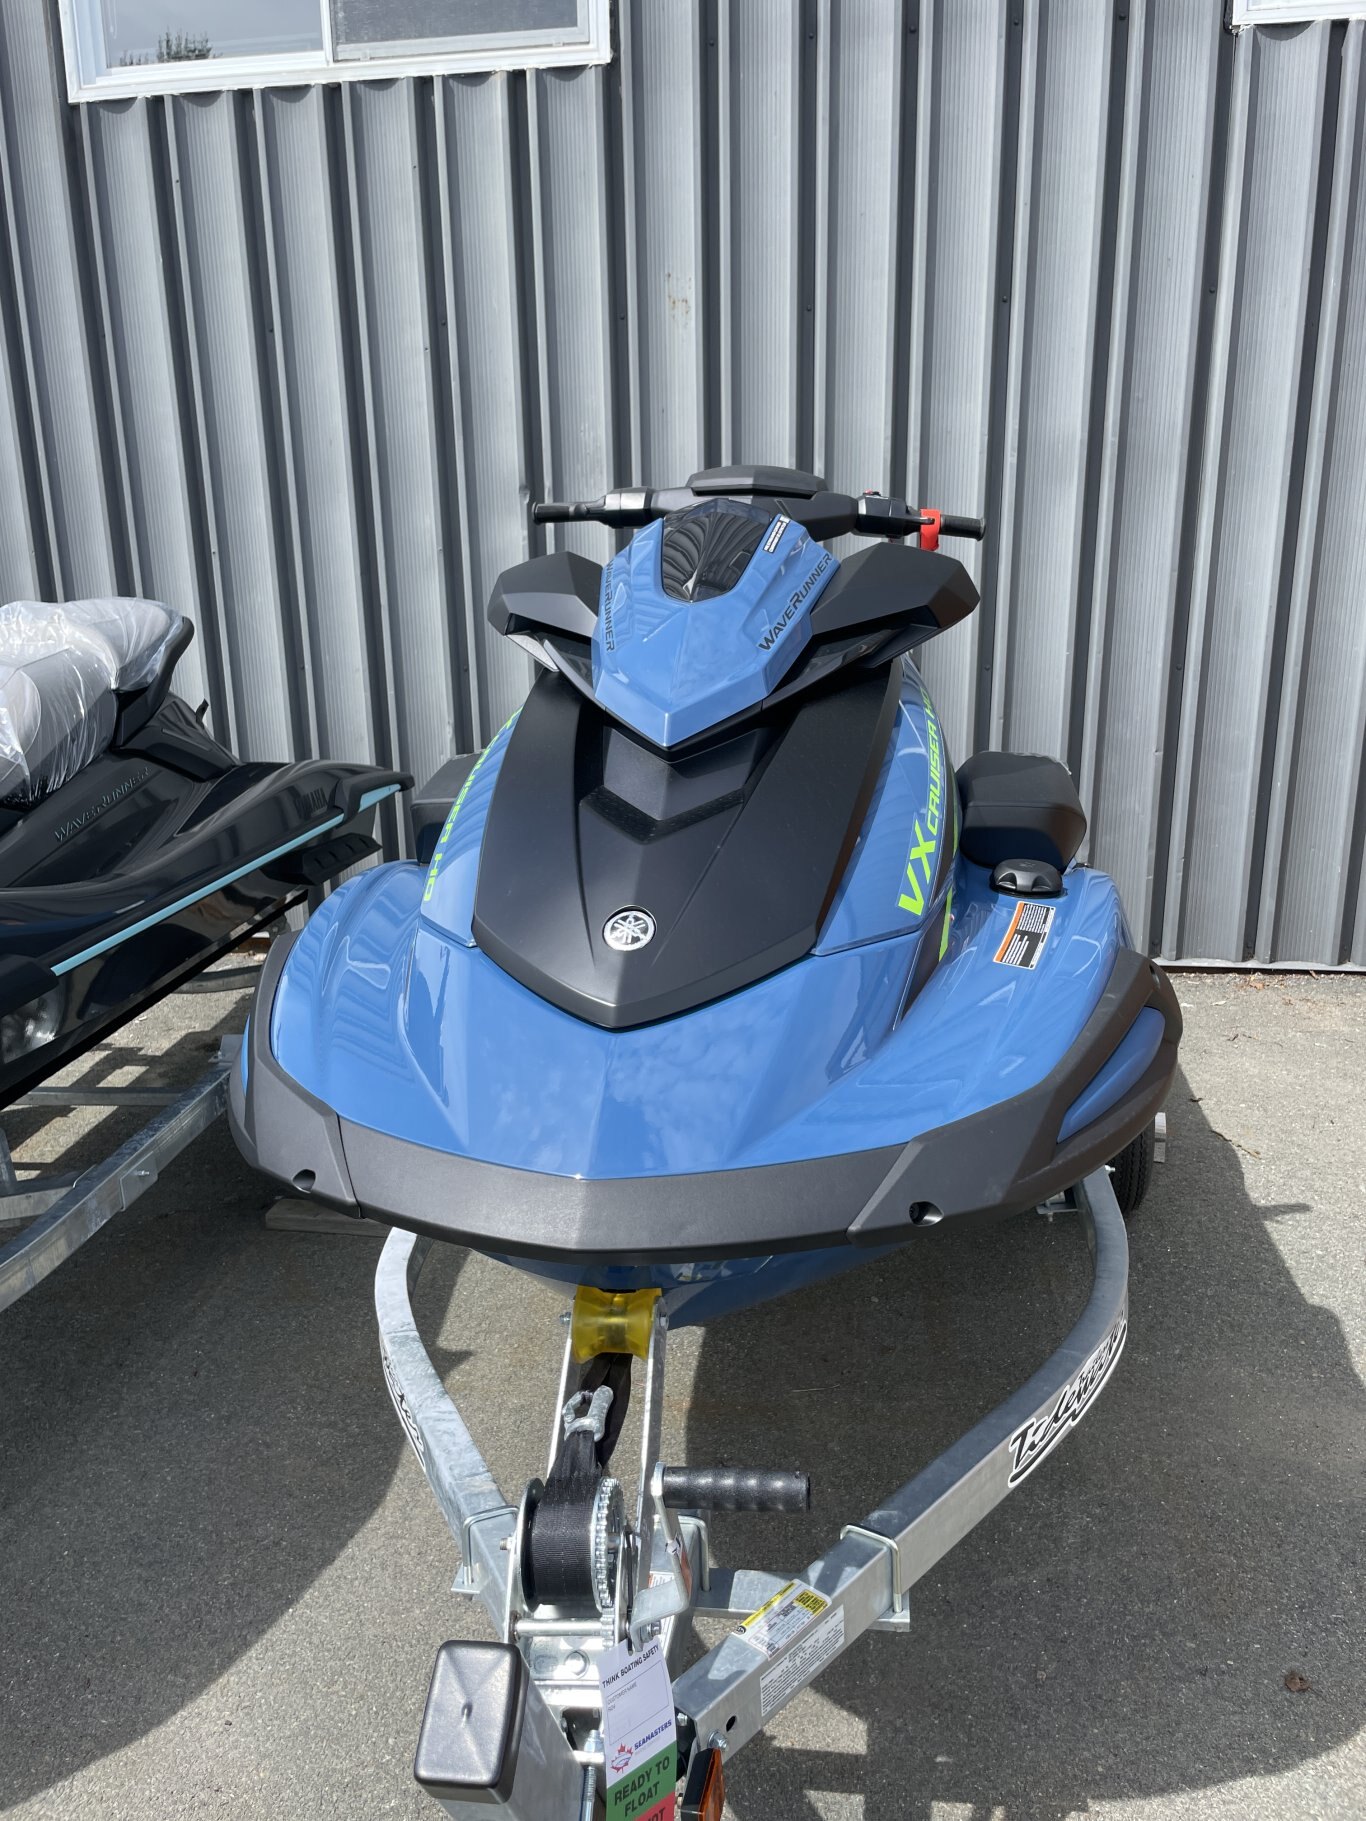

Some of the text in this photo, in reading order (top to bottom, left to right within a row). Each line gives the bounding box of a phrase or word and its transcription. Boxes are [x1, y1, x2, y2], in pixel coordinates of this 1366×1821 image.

[758, 552, 834, 652] WAVERUNNER
[423, 853, 443, 902] HO
[897, 819, 937, 917] VX
[601, 1643, 660, 1689] THINK BOATING SAFETY
[634, 1719, 672, 1750] SEAMASTERS
[614, 1756, 670, 1807] READY TO
[624, 1781, 660, 1817] FLOAT
[648, 1806, 666, 1821] OT
